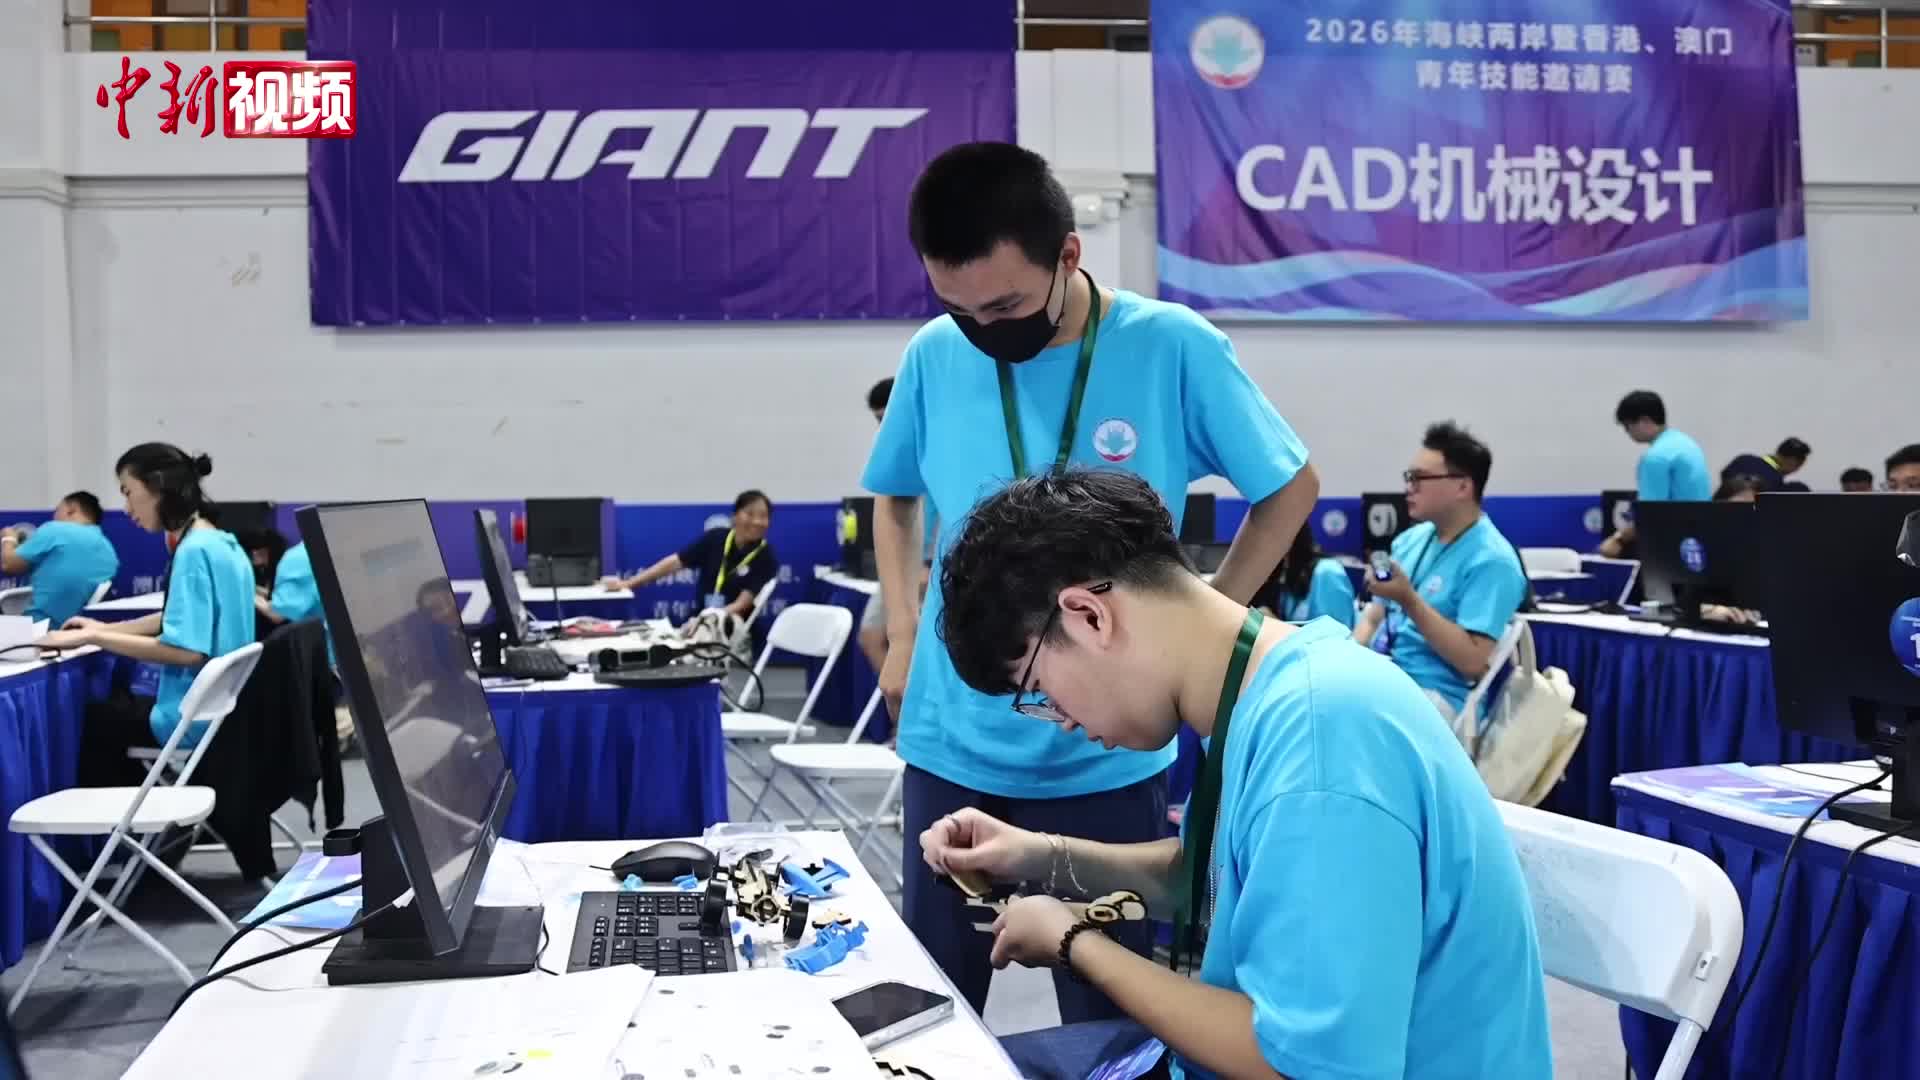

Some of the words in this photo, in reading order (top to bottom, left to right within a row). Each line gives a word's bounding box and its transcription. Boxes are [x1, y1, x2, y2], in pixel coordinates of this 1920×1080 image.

[1306, 18, 1732, 55] 2026年海峡两岸暨香港、澳门
[1415, 60, 1633, 93] 青年技能邀请赛
[398, 107, 929, 183] GIANT
[1235, 143, 1714, 226] CAD机械设计
